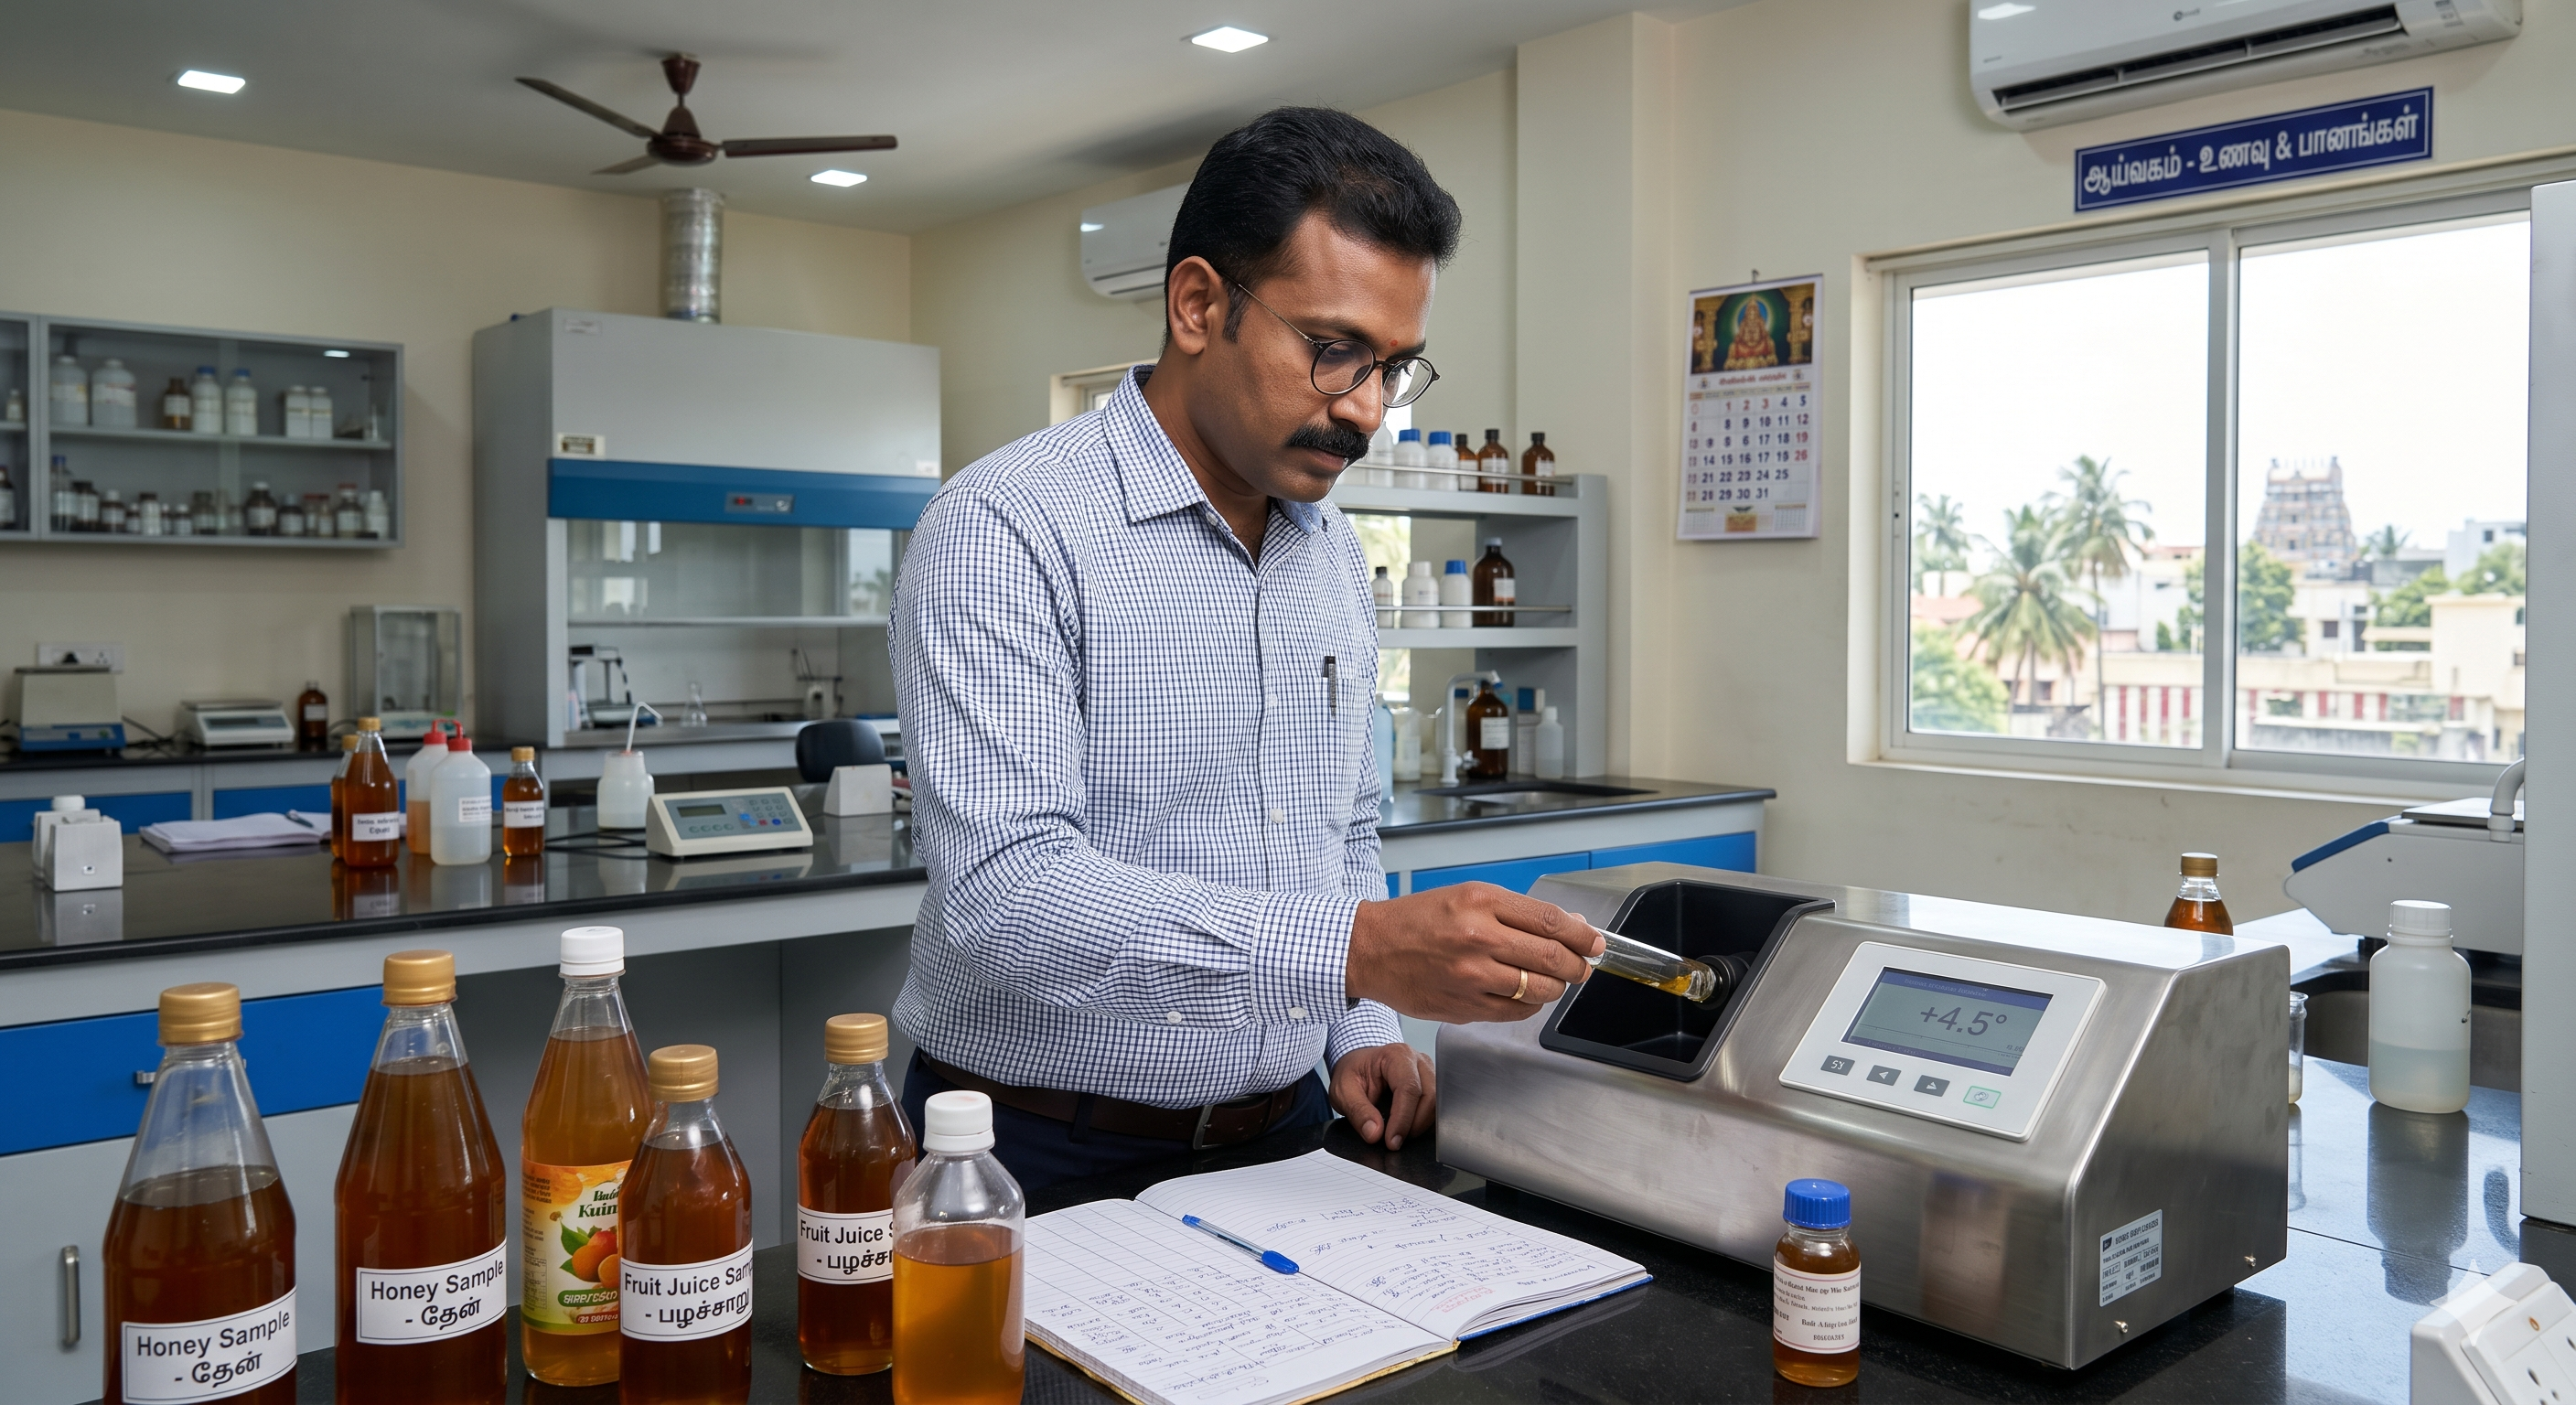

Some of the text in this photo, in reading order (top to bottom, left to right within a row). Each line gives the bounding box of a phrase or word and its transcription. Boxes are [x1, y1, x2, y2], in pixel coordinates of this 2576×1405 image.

[2084, 145, 2182, 196] ஆய்வகம்
[2199, 138, 2270, 174] உணவு
[2275, 131, 2292, 160] &
[2299, 103, 2419, 157] பானங்கள்
[1744, 400, 1750, 411] 2
[1762, 398, 1768, 409] 3
[1780, 396, 1787, 407] 4
[1799, 394, 1806, 406] 5
[1759, 415, 1771, 427] 10
[1778, 414, 1788, 425] 11
[1797, 413, 1809, 425] 12
[1759, 434, 1770, 445] 17
[1777, 432, 1789, 444] 18
[1796, 431, 1809, 443] 19
[1704, 455, 1715, 466] 14
[1758, 451, 1770, 463] 17
[1701, 472, 1713, 484] 21
[1720, 471, 1732, 483] 22
[1738, 470, 1751, 482] 23
[1756, 469, 1769, 481] 24
[1775, 468, 1788, 480] 25
[1719, 488, 1732, 500] 29
[1736, 488, 1751, 499] 30
[1755, 488, 1768, 499] 31
[1919, 1006, 2008, 1035] +4.5°
[800, 1219, 830, 1243] Fruit
[834, 1227, 883, 1244] Juice
[371, 1281, 438, 1303] Honey
[445, 1260, 503, 1293] Sample
[625, 1272, 661, 1296] Fruit
[667, 1275, 720, 1296] Juice
[421, 1296, 482, 1331] தேன்
[137, 1311, 290, 1358] Honey Sample
[191, 1351, 263, 1388] தேன்
